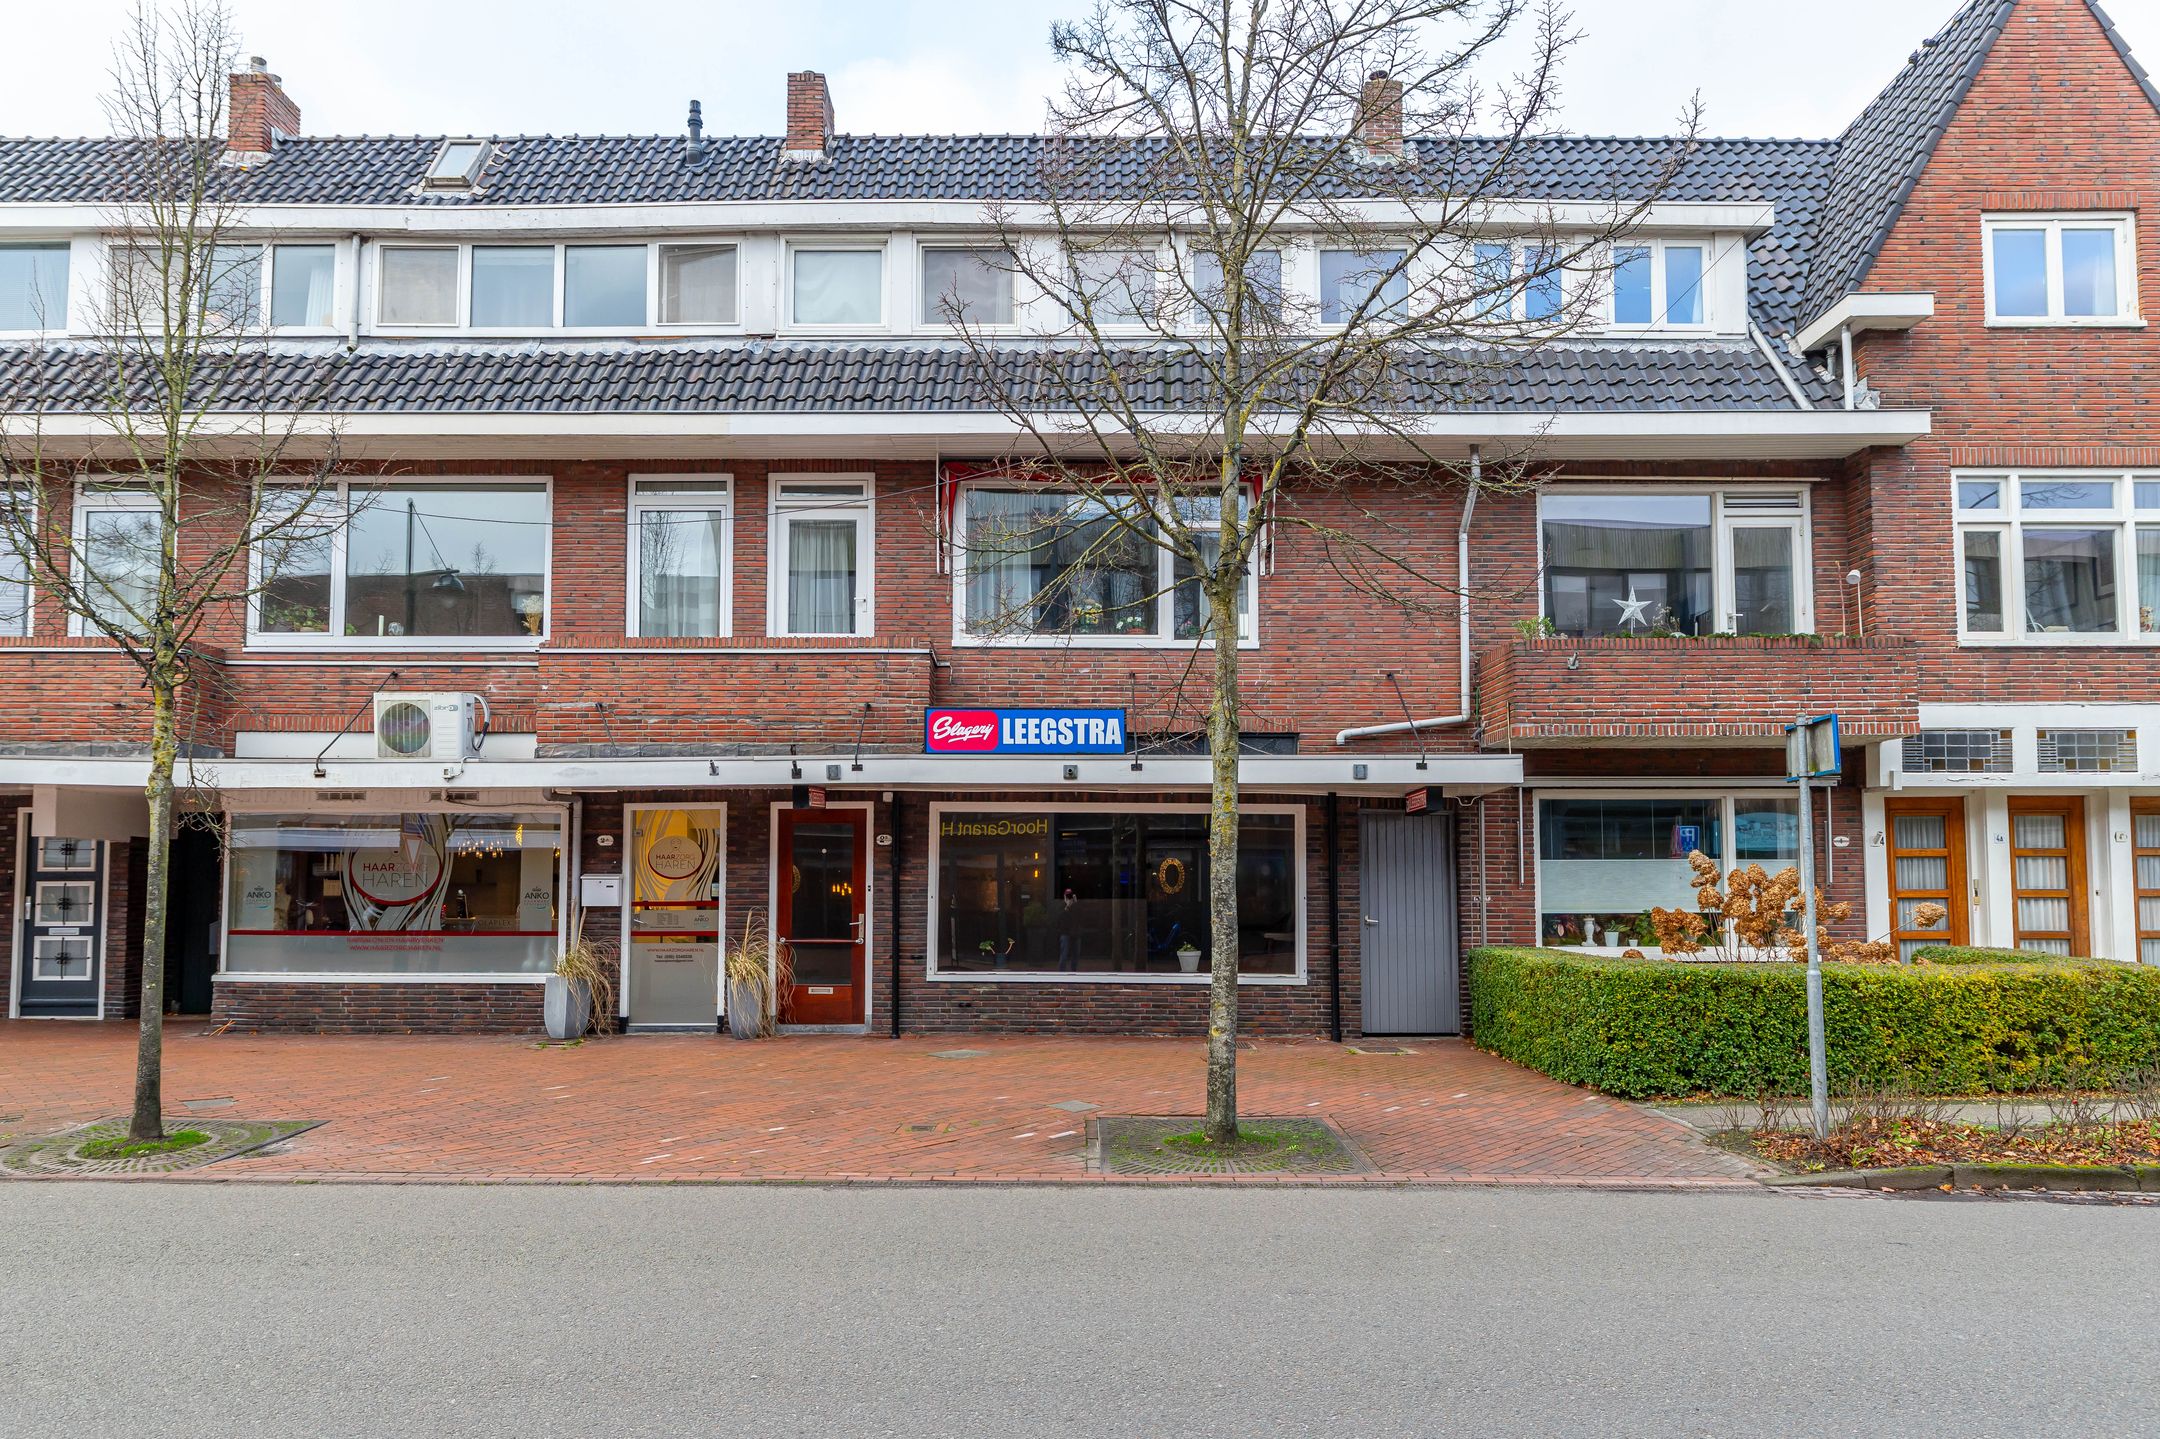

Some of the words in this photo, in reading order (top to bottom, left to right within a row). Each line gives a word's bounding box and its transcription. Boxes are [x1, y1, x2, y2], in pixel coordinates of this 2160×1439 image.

[1002, 718, 1122, 745] LEEGSTRA
[655, 860, 696, 869] HAREN
[362, 873, 428, 887] HAREN
[246, 891, 272, 899] ANKO
[524, 892, 550, 900] ANKO
